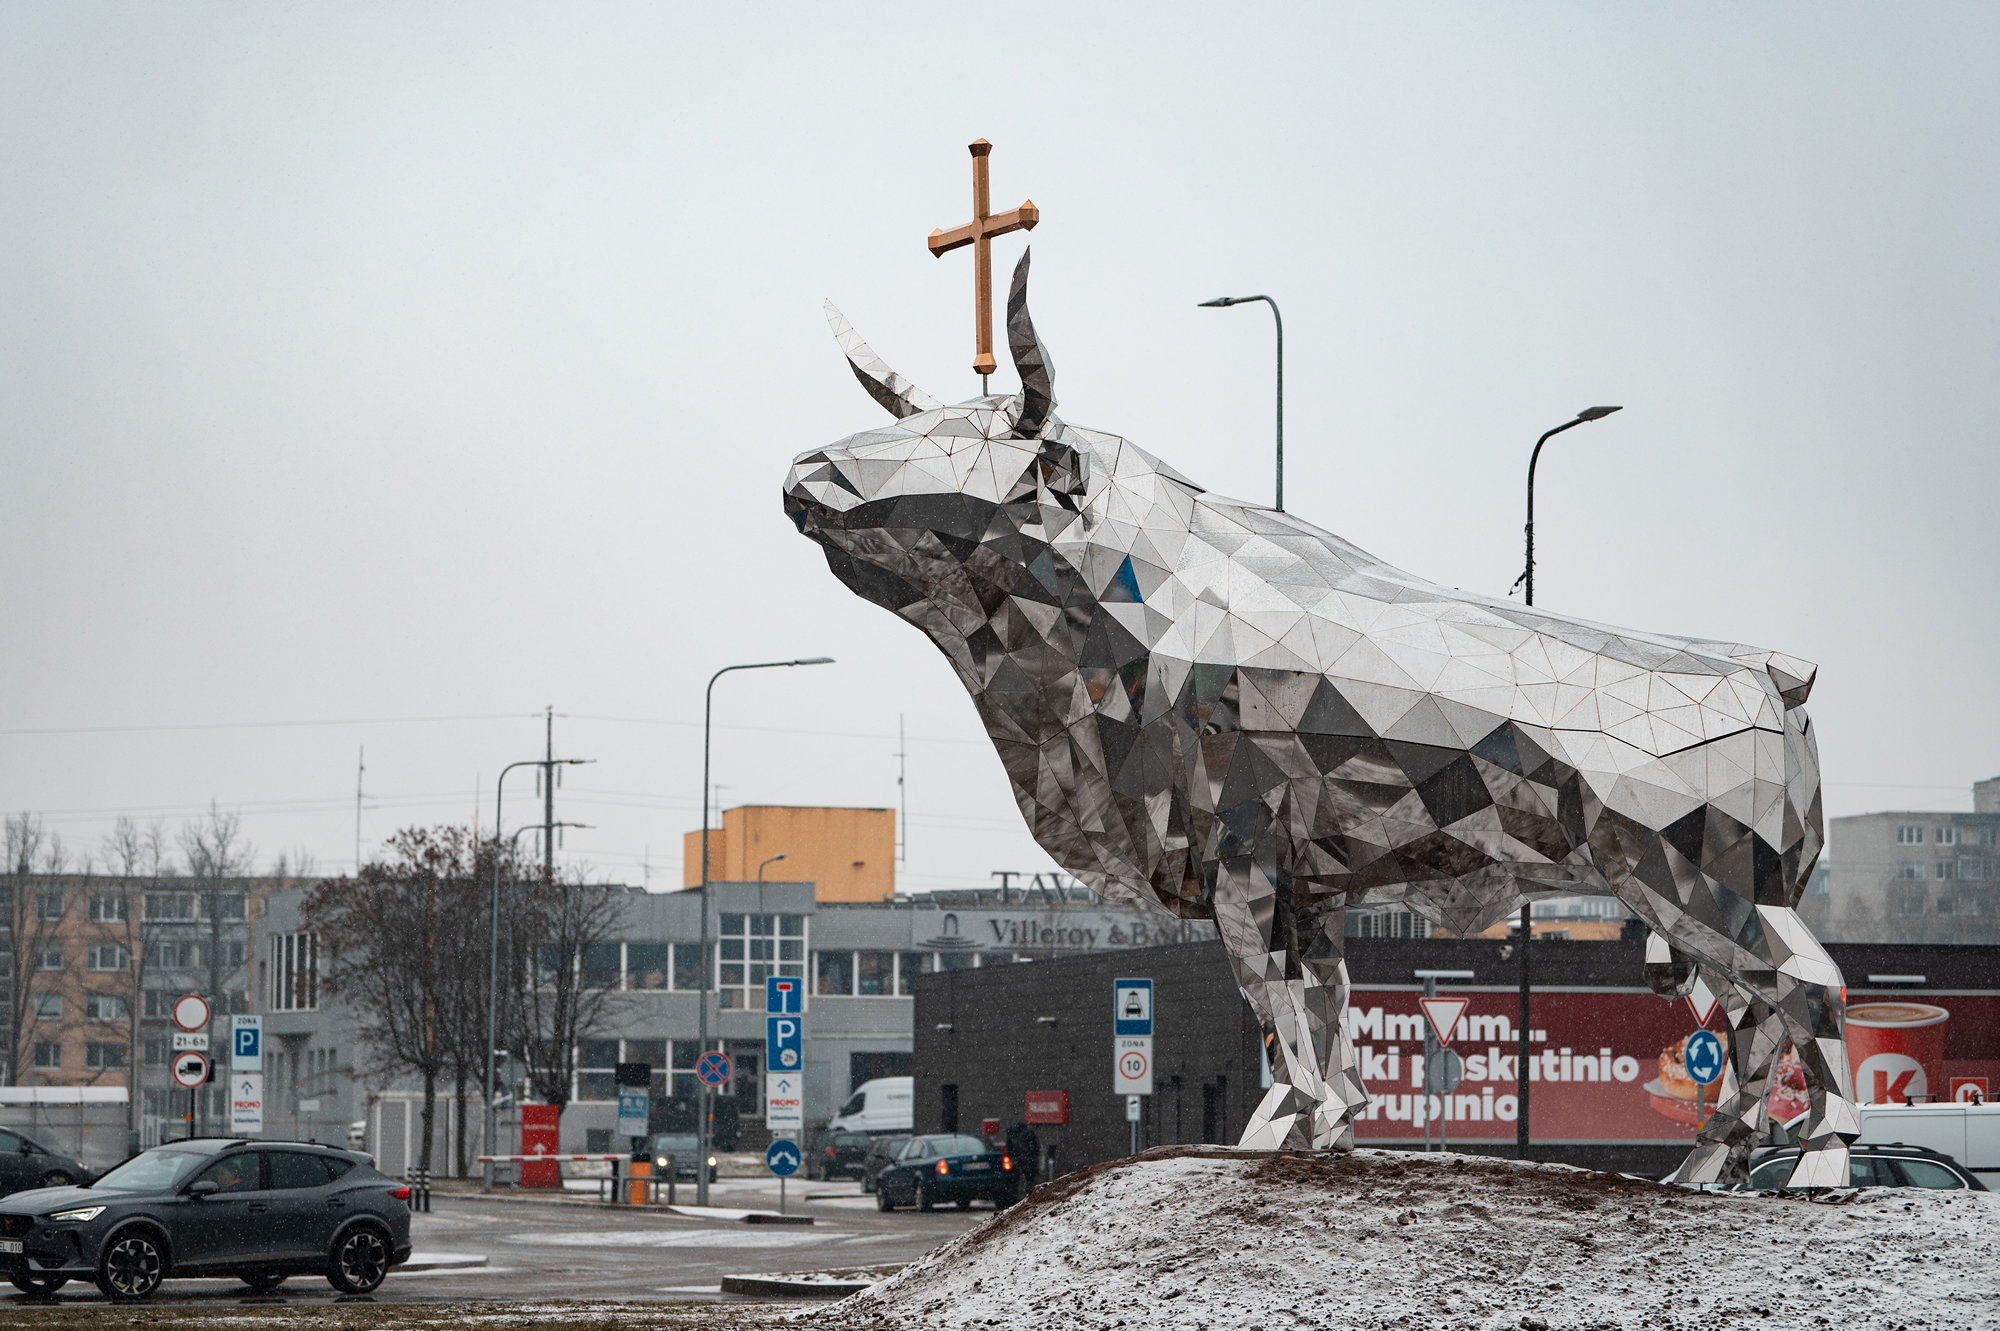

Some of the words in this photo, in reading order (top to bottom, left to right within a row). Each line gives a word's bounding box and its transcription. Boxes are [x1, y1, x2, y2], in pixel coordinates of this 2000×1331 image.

[988, 918, 1100, 950] Villeroy
[1108, 924, 1125, 945] &
[237, 1017, 257, 1025] ZONA
[240, 1031, 254, 1055] P
[777, 1019, 796, 1048] P
[1121, 1040, 1145, 1048] ZONA
[1126, 1060, 1141, 1072] 10
[1411, 1047, 1640, 1088] pskutinio
[1873, 1069, 1918, 1104] K
[1963, 1089, 1979, 1103] K
